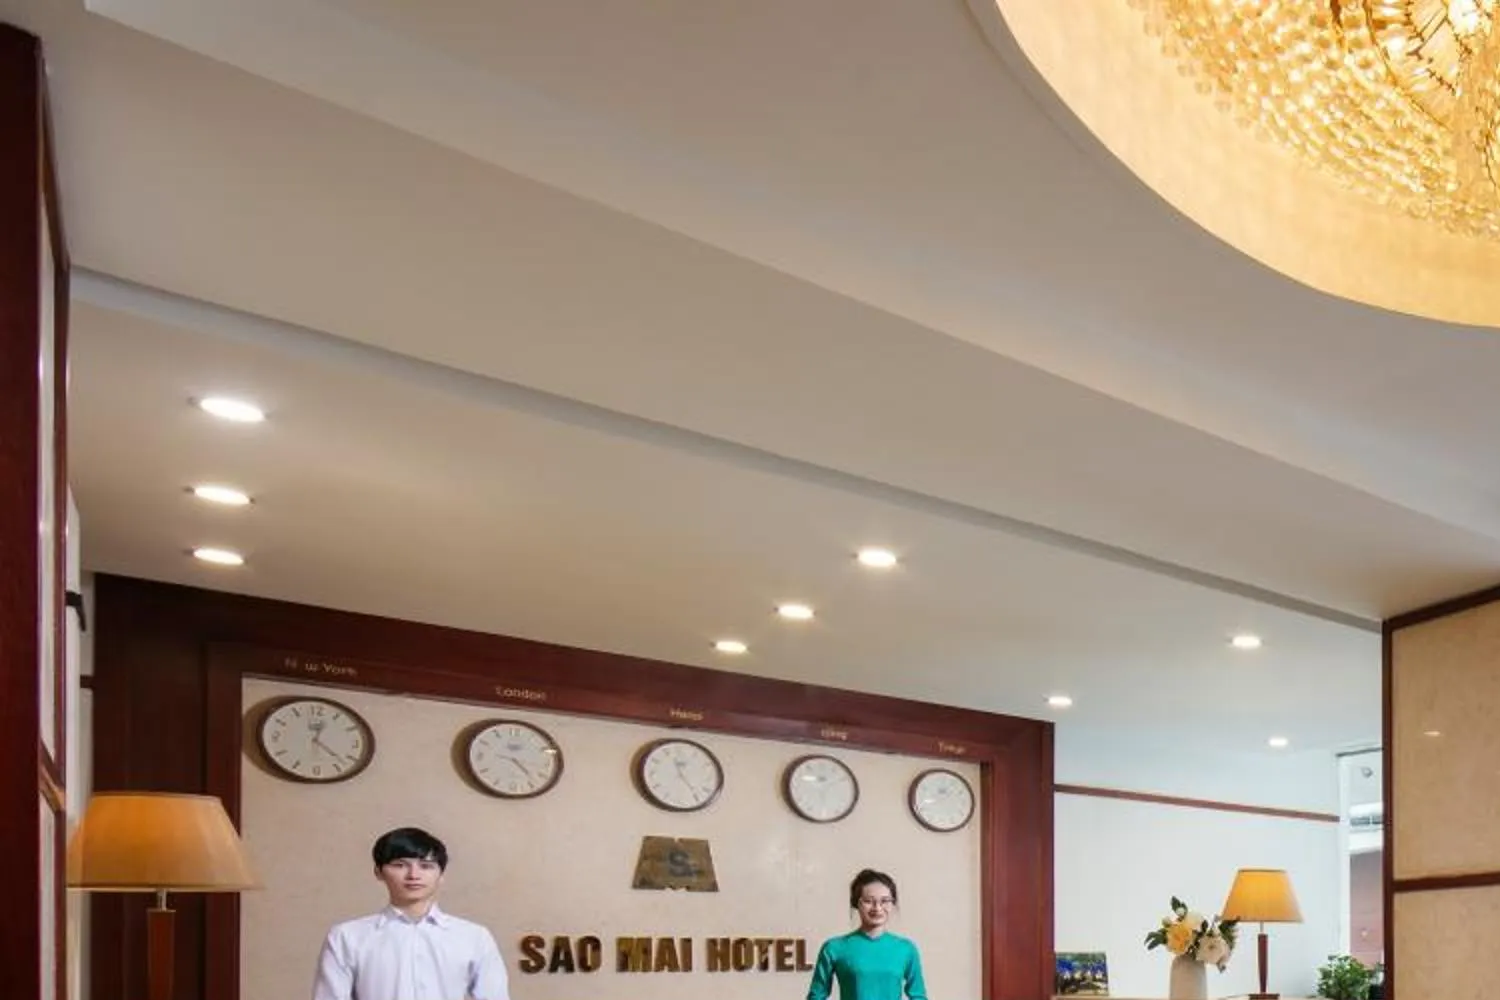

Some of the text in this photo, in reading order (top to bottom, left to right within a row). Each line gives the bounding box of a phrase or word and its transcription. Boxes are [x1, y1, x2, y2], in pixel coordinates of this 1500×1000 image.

[519, 935, 814, 974] SAO MAI HOTEL
